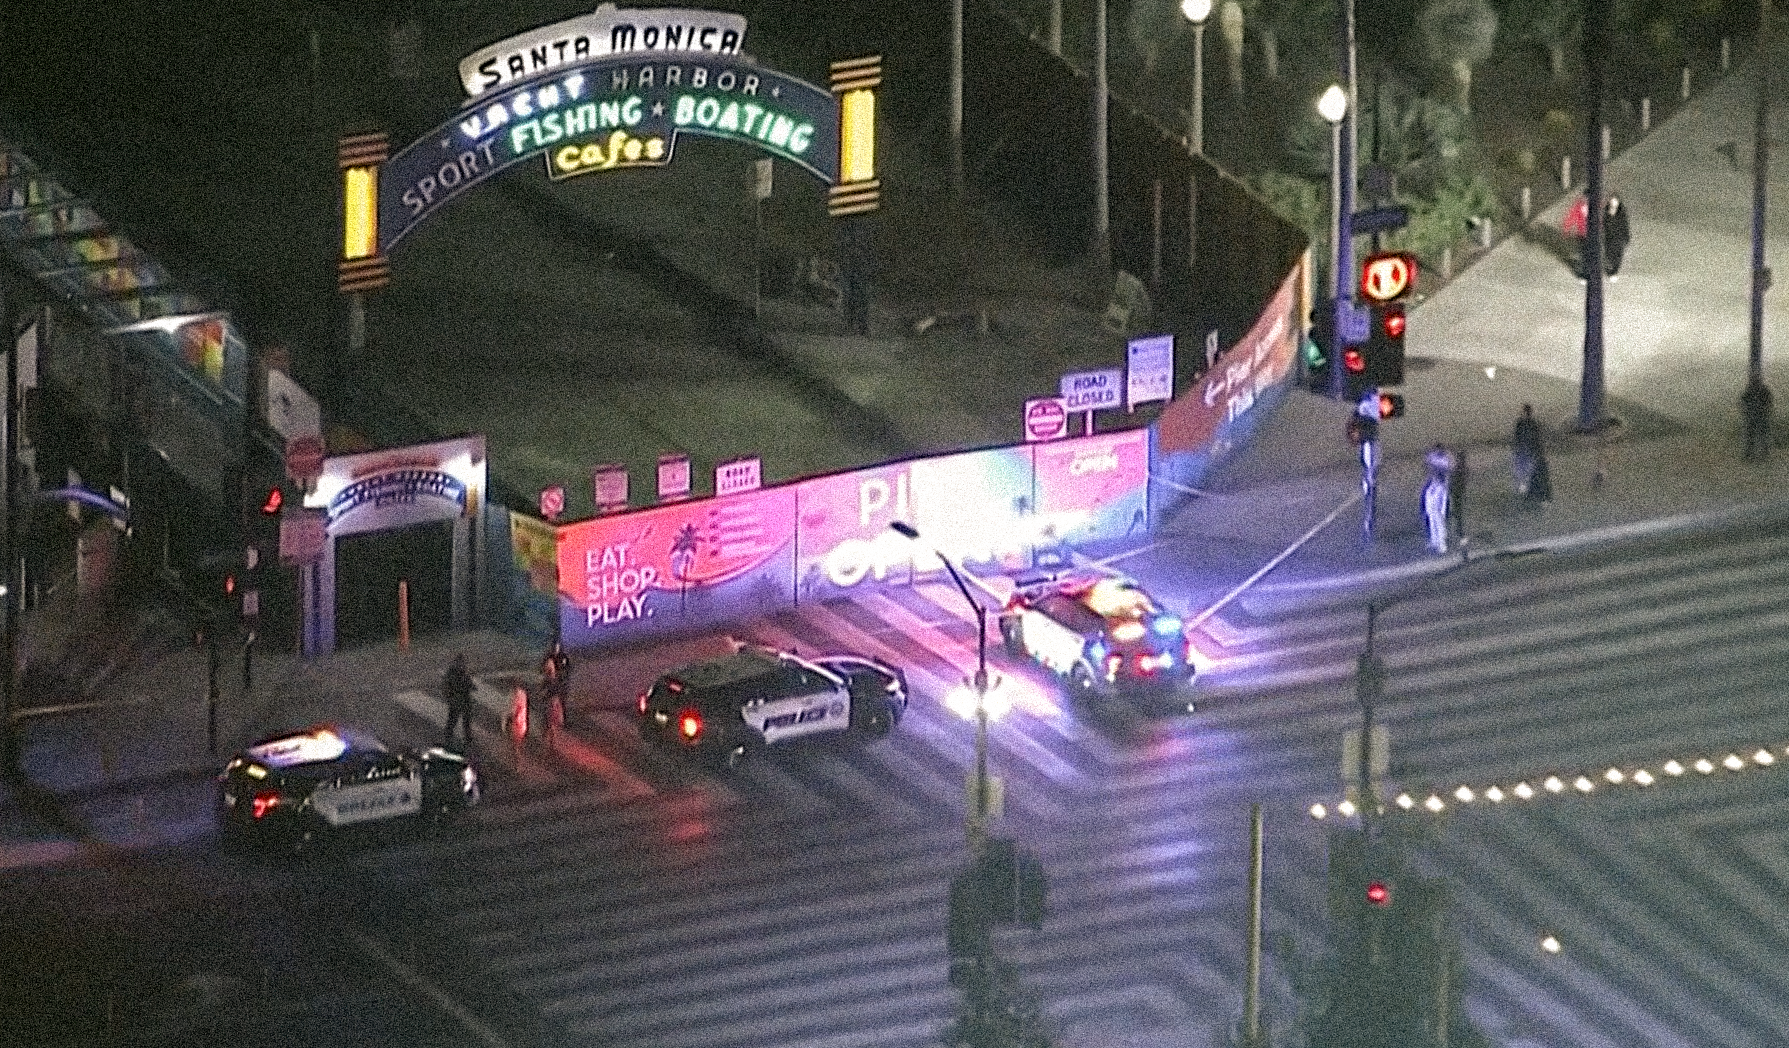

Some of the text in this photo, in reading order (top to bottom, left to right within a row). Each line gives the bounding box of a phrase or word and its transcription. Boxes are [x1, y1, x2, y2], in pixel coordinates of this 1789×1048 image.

[478, 23, 740, 89] SANTA MONICA
[459, 65, 762, 140] YACHT HARBOR
[400, 95, 816, 216] SPORT FISHING BOATING
[556, 130, 666, 172] cafes
[1073, 374, 1107, 390] ROAD
[586, 542, 636, 573] EAT.
[586, 566, 661, 601] SHOP.
[586, 594, 654, 628] PLAY.
